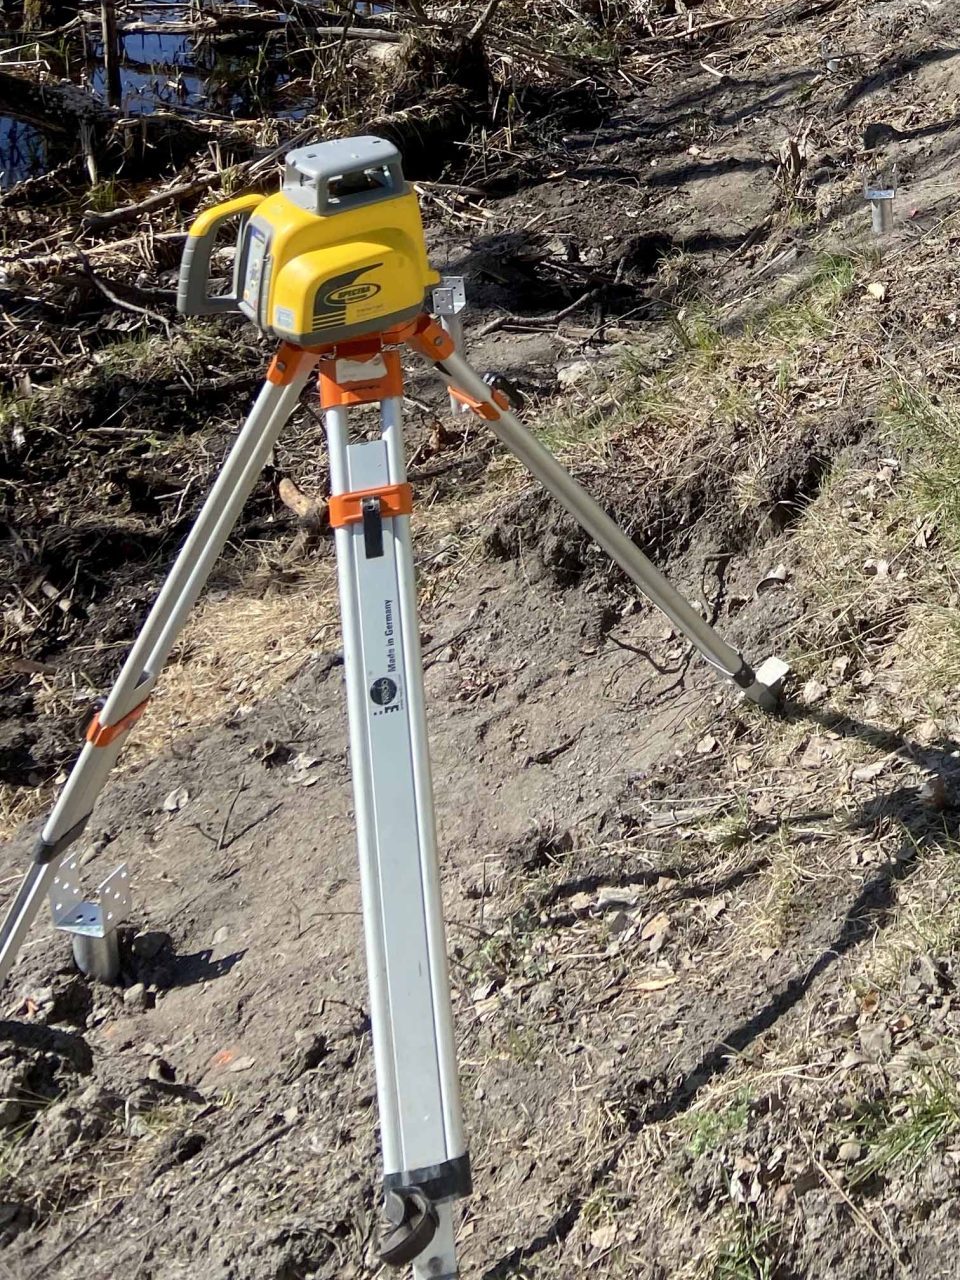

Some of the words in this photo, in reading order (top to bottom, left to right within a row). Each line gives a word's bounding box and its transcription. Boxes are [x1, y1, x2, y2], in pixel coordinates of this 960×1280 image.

[338, 285, 371, 299] SPECTRA
[384, 599, 394, 636] Germany
[386, 638, 395, 647] in
[388, 648, 396, 673] Made
